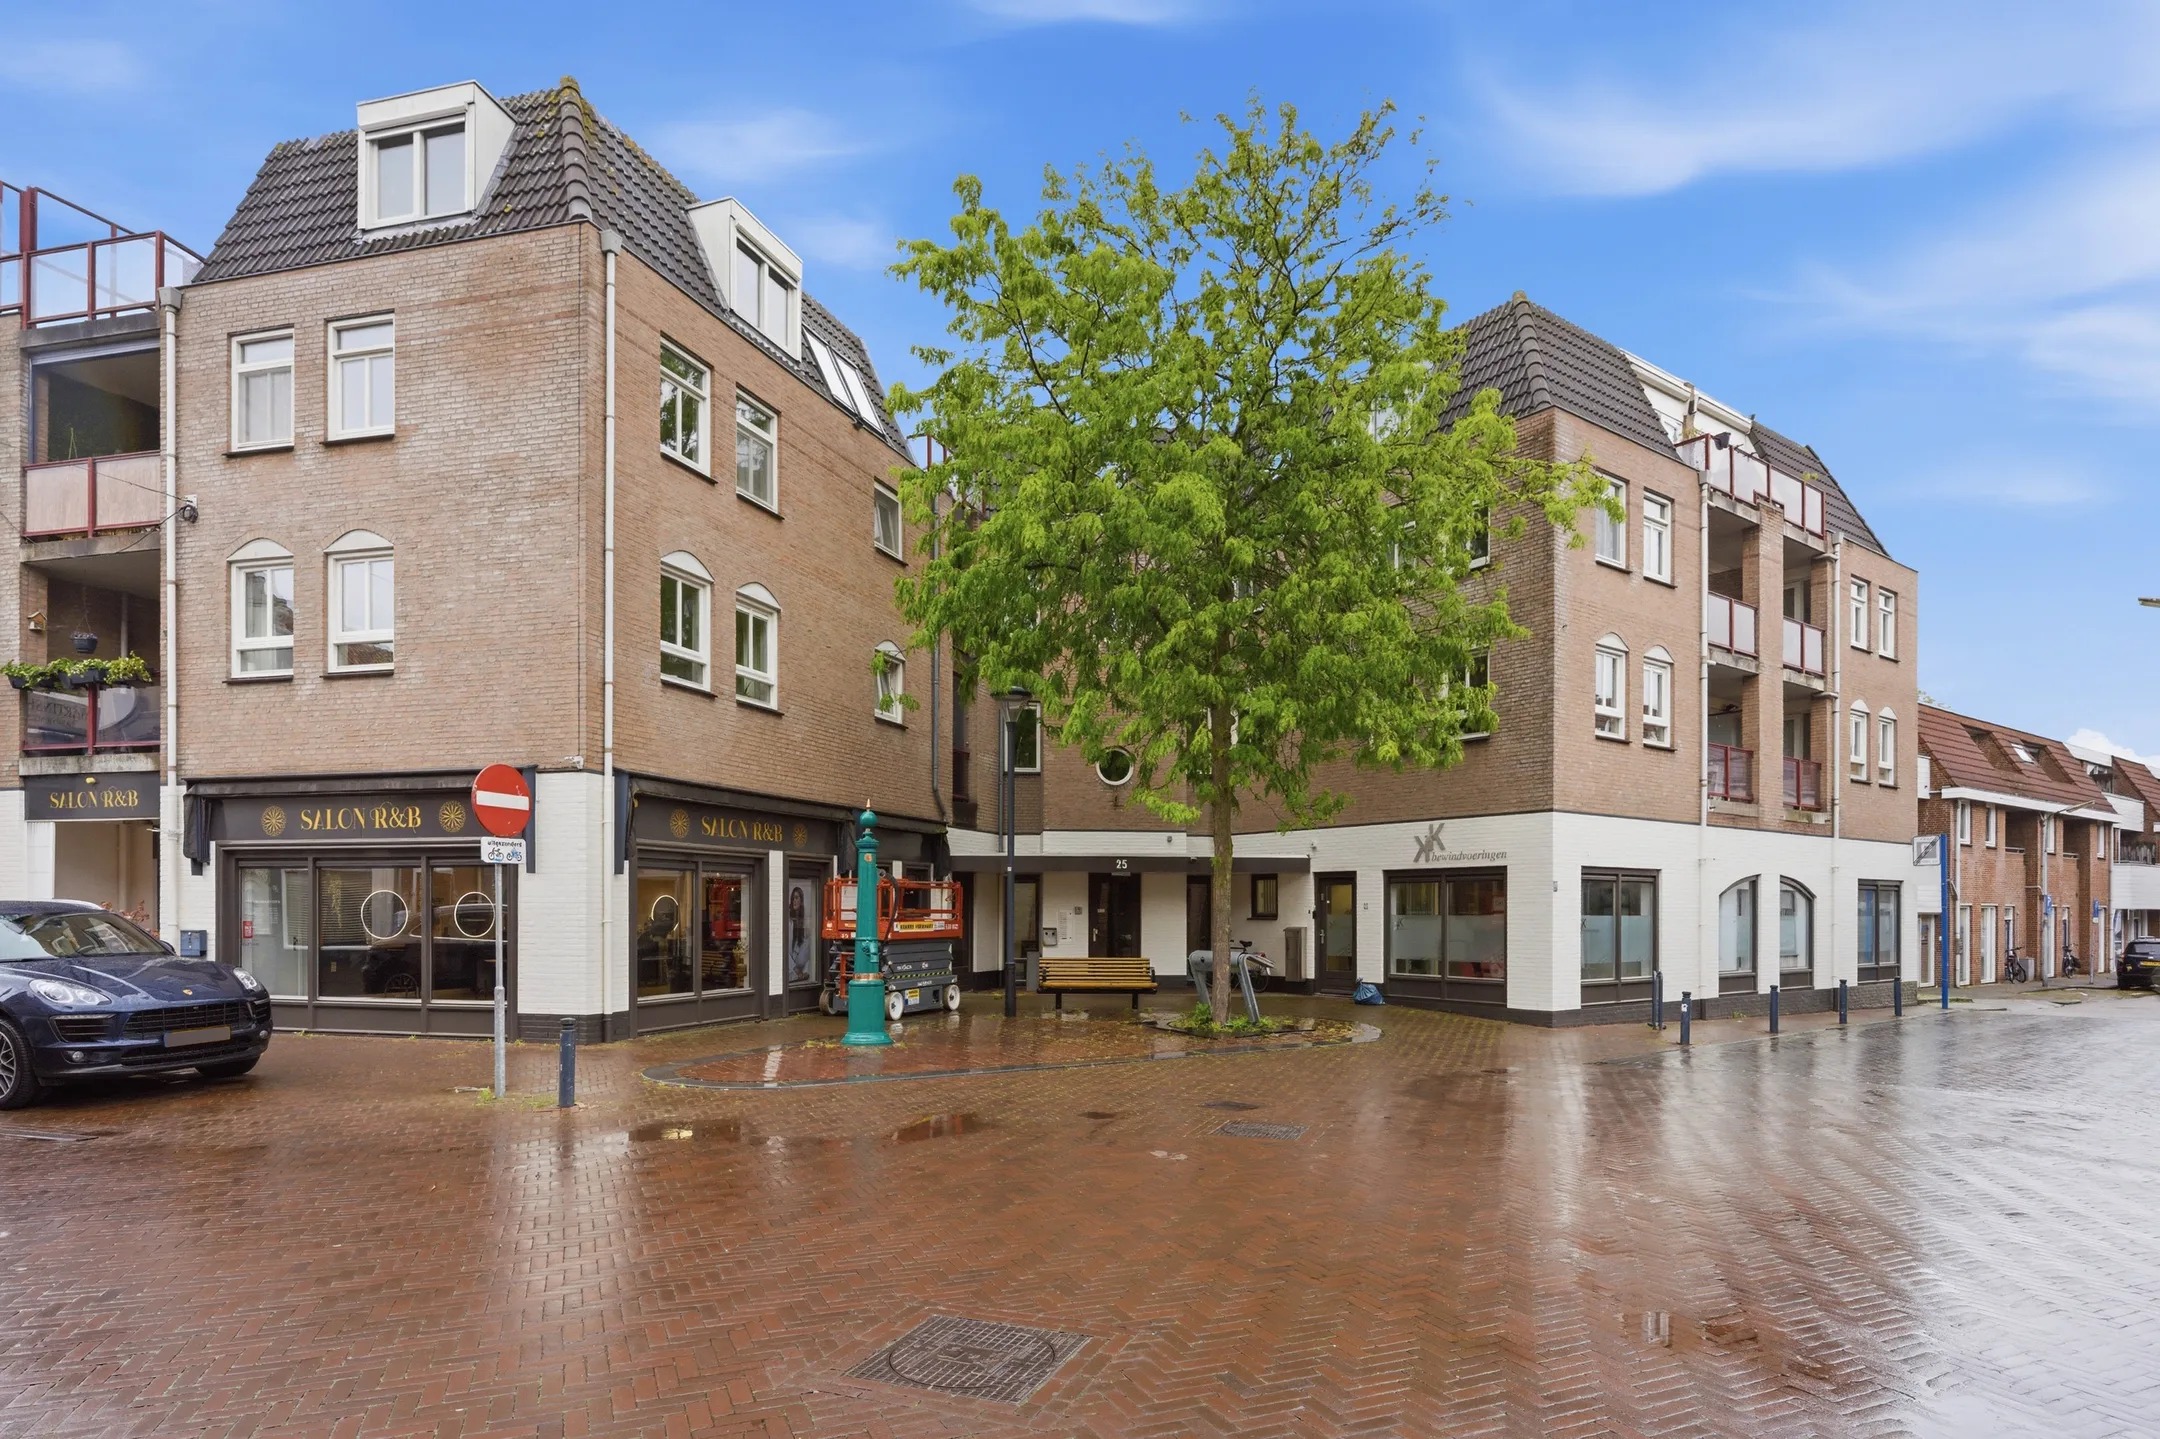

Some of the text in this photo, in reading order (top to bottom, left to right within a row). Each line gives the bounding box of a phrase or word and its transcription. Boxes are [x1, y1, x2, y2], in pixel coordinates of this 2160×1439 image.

[50, 787, 139, 809] SALON R&B
[300, 801, 422, 834] SALON R&B
[701, 815, 783, 843] SALON R&B
[1116, 859, 1128, 869] 25
[1431, 849, 1508, 862] bewindvoeringen
